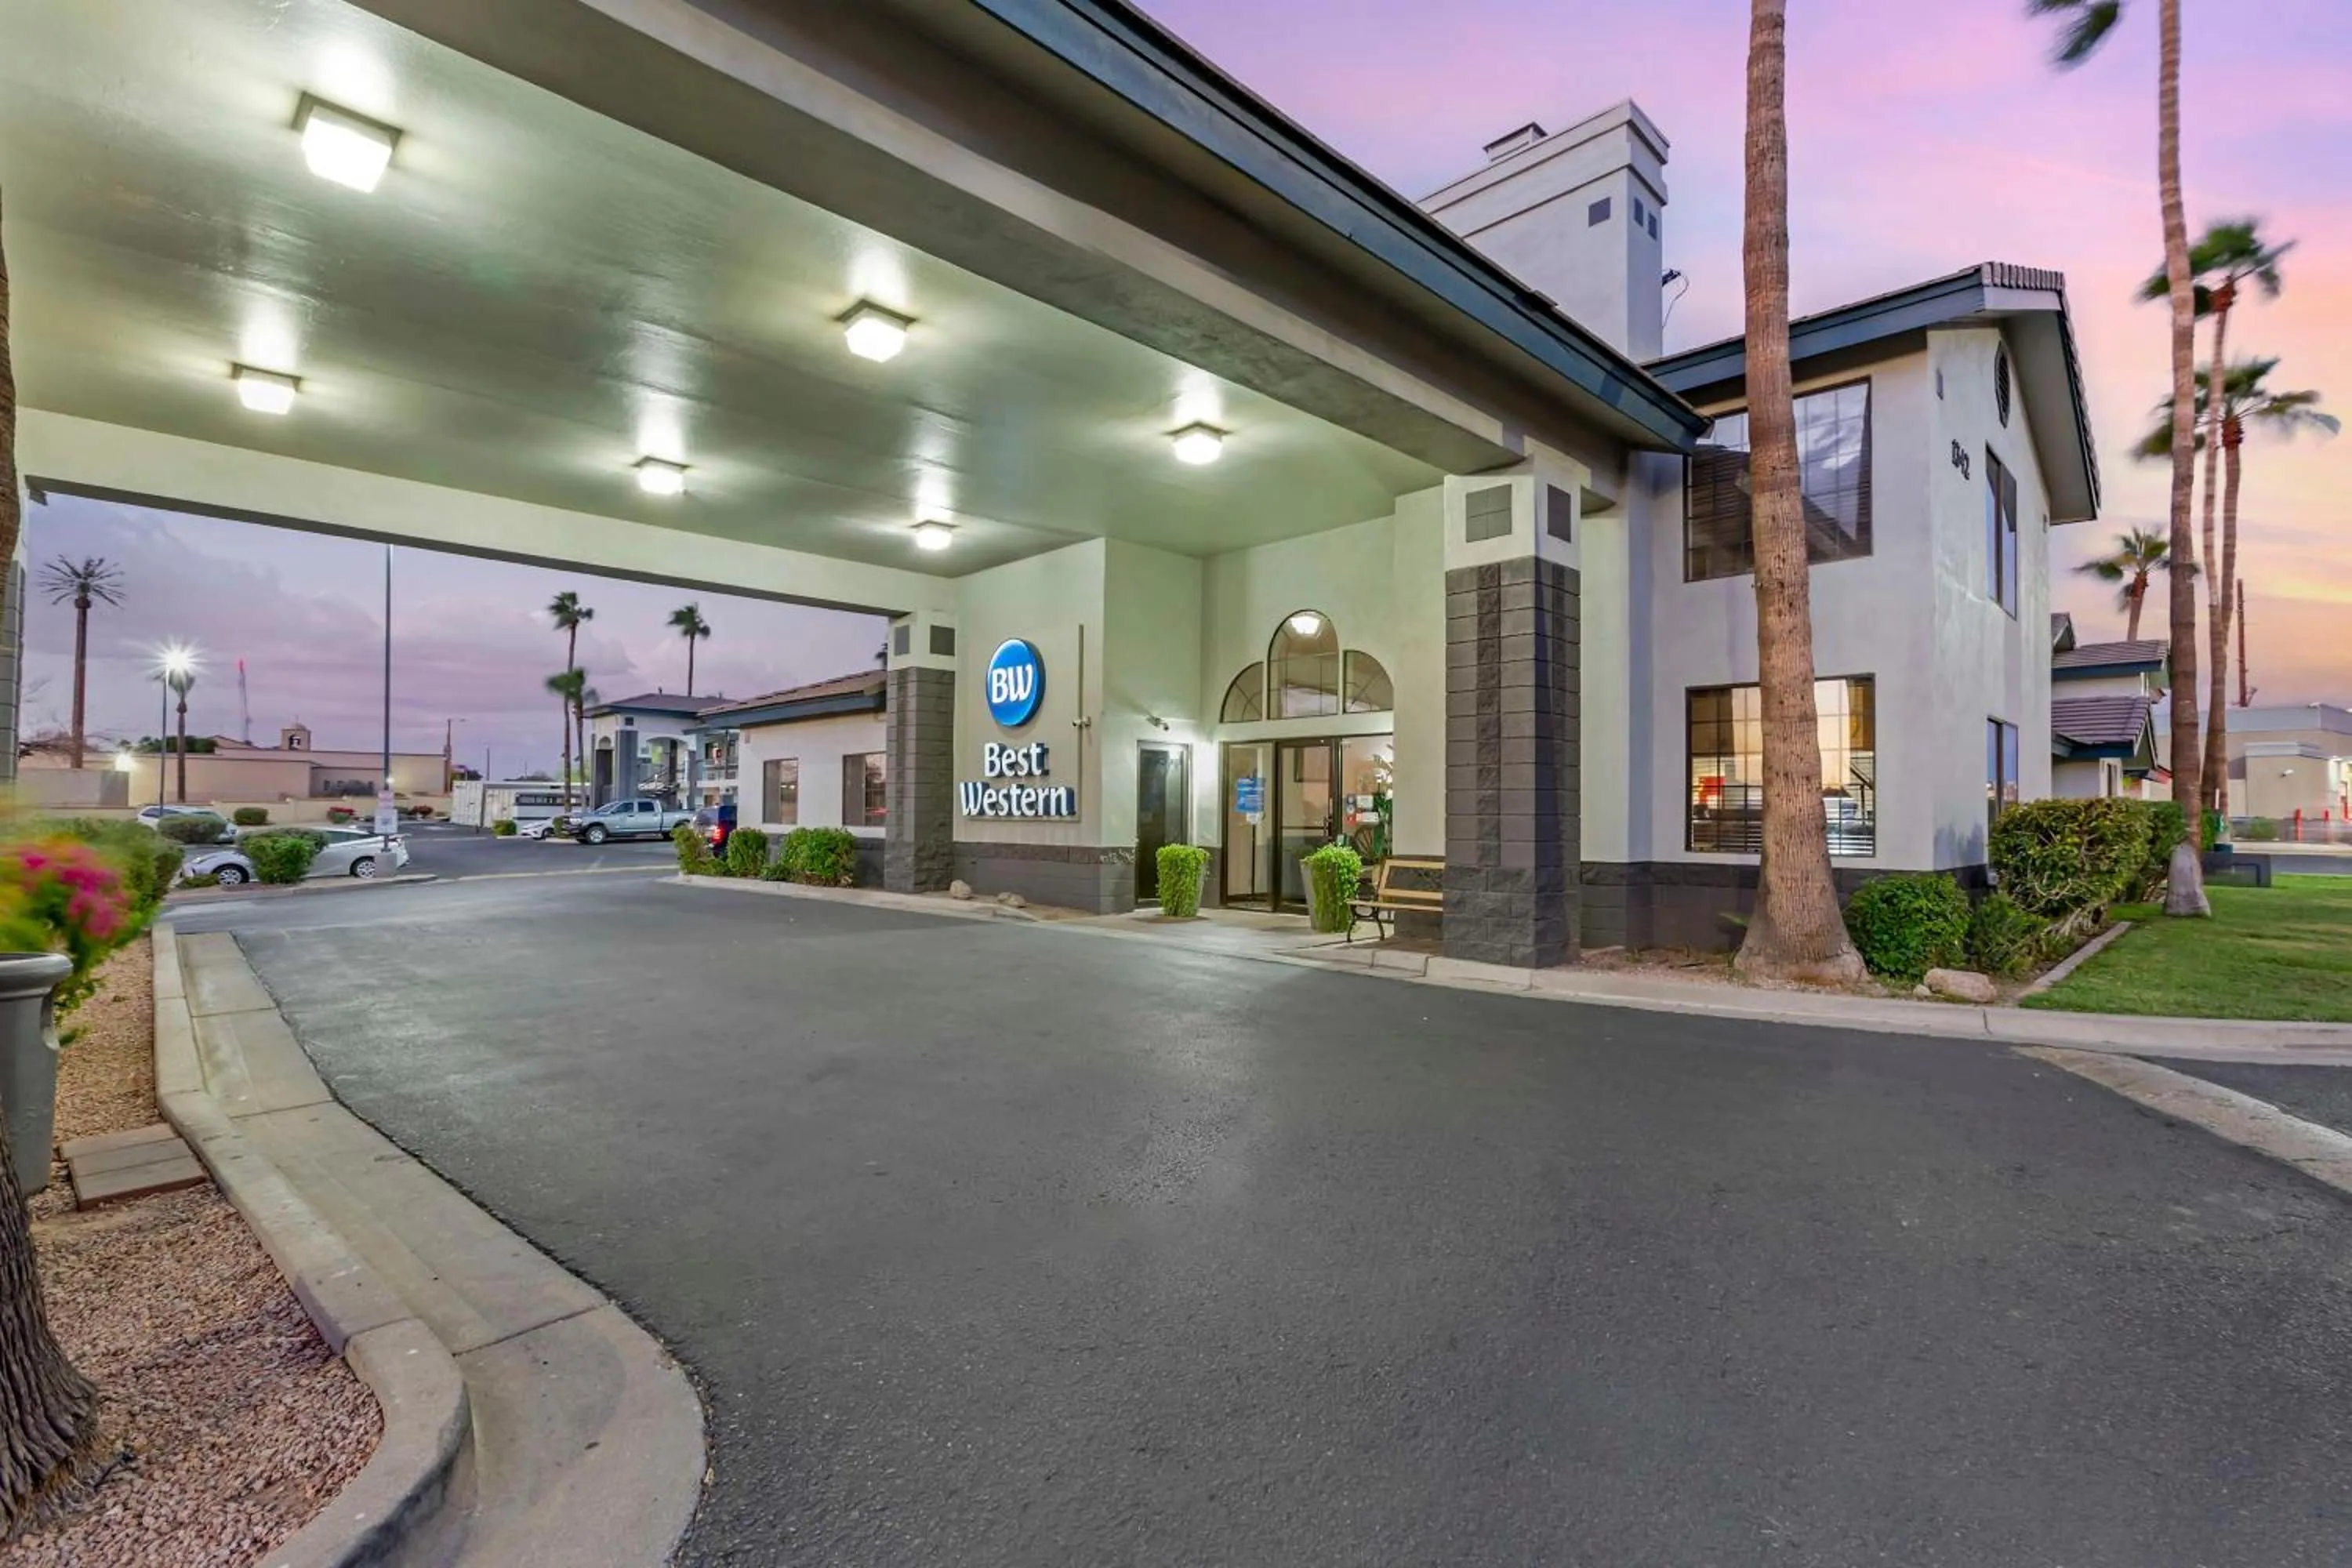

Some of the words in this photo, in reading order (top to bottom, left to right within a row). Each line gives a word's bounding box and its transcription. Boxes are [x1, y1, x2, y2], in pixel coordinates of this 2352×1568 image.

[991, 663, 1033, 704] BW
[984, 742, 1044, 778] Best
[959, 781, 1069, 817] Western
